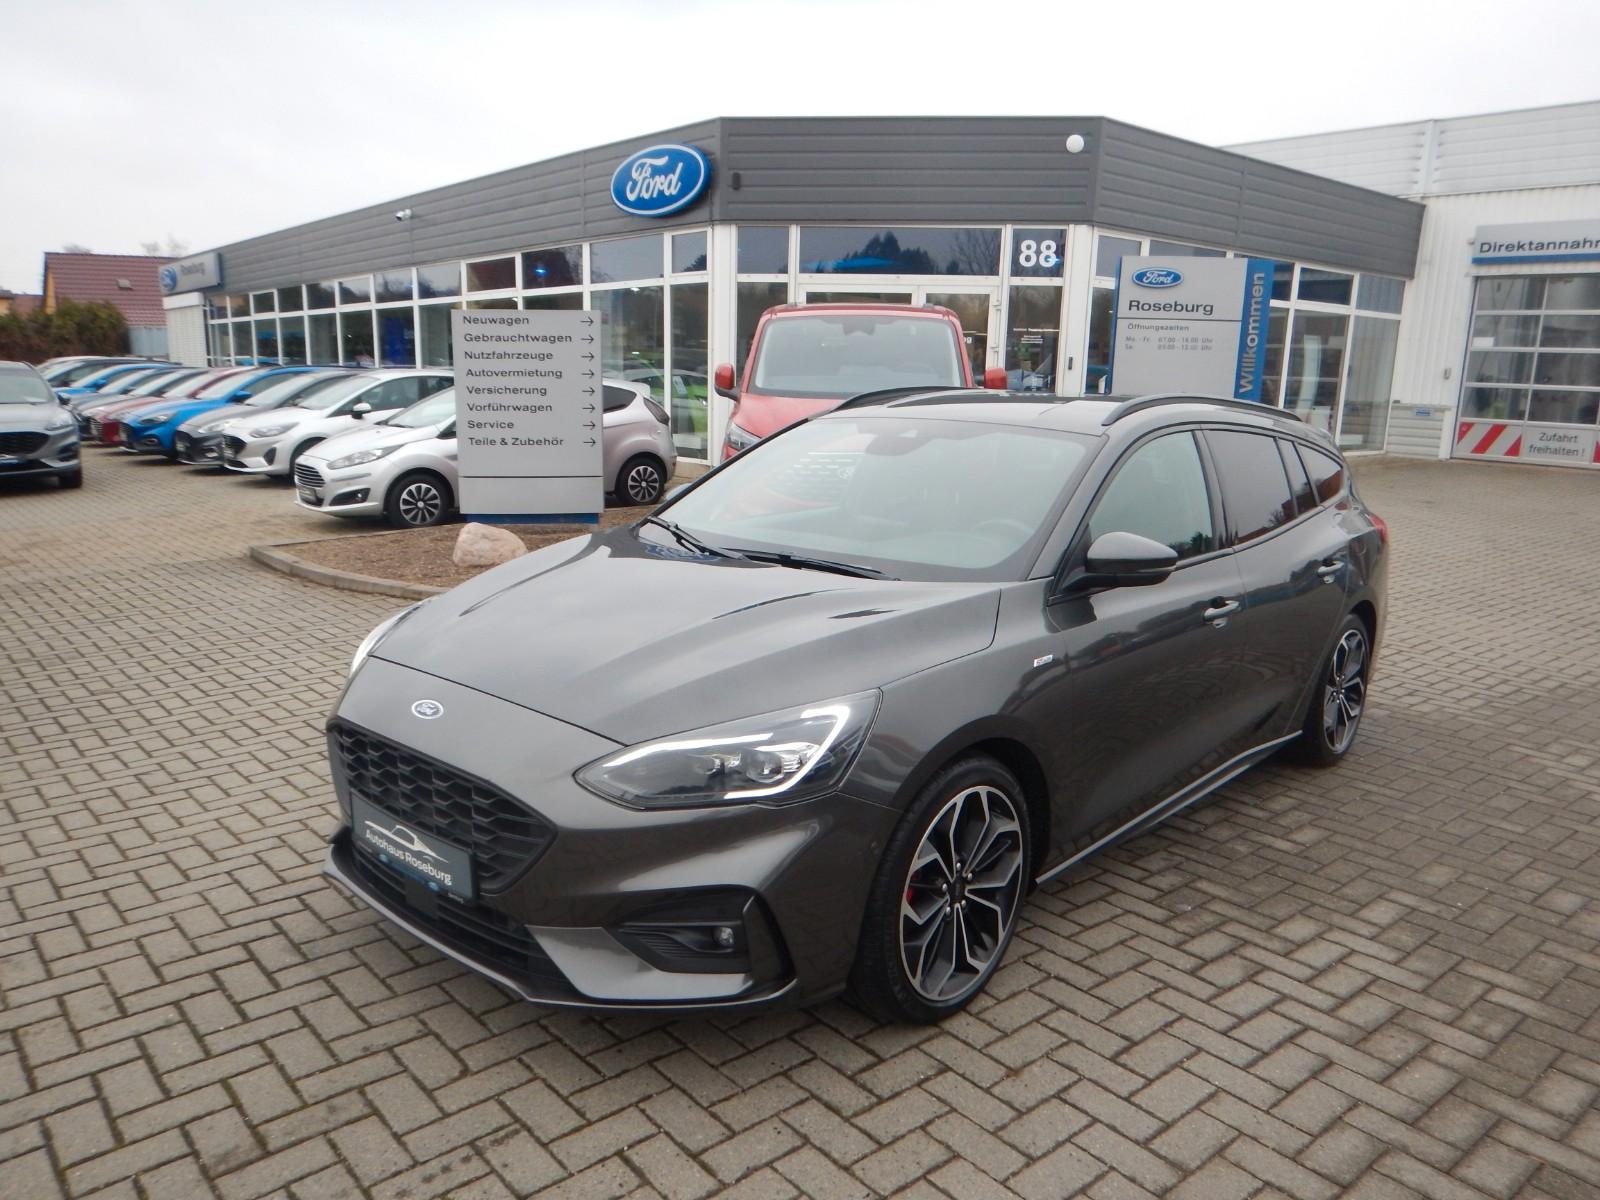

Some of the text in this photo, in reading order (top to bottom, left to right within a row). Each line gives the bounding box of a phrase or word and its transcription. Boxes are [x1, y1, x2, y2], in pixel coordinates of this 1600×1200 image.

[626, 155, 683, 202] Ford
[1019, 239, 1057, 268] 88
[1143, 269, 1175, 284] Ford
[1128, 299, 1214, 316] Roseburg
[463, 316, 530, 326] Neuwagen
[1127, 322, 1189, 332] Öffnungszeiten
[1239, 272, 1265, 393] Willkommen
[463, 333, 573, 344] Gebrauchtwagen
[464, 351, 554, 361] Nutzfahrzeuge
[466, 368, 563, 379] Autovermietung
[466, 386, 548, 397] Versicherung
[467, 402, 553, 413] Vorführwagen
[467, 420, 515, 430] Service
[468, 436, 564, 447] Teile & Zubehör
[1538, 431, 1579, 443] Zufahrt
[1528, 444, 1580, 457] freihalten
[366, 829, 453, 886] Autohaus Roseburg
